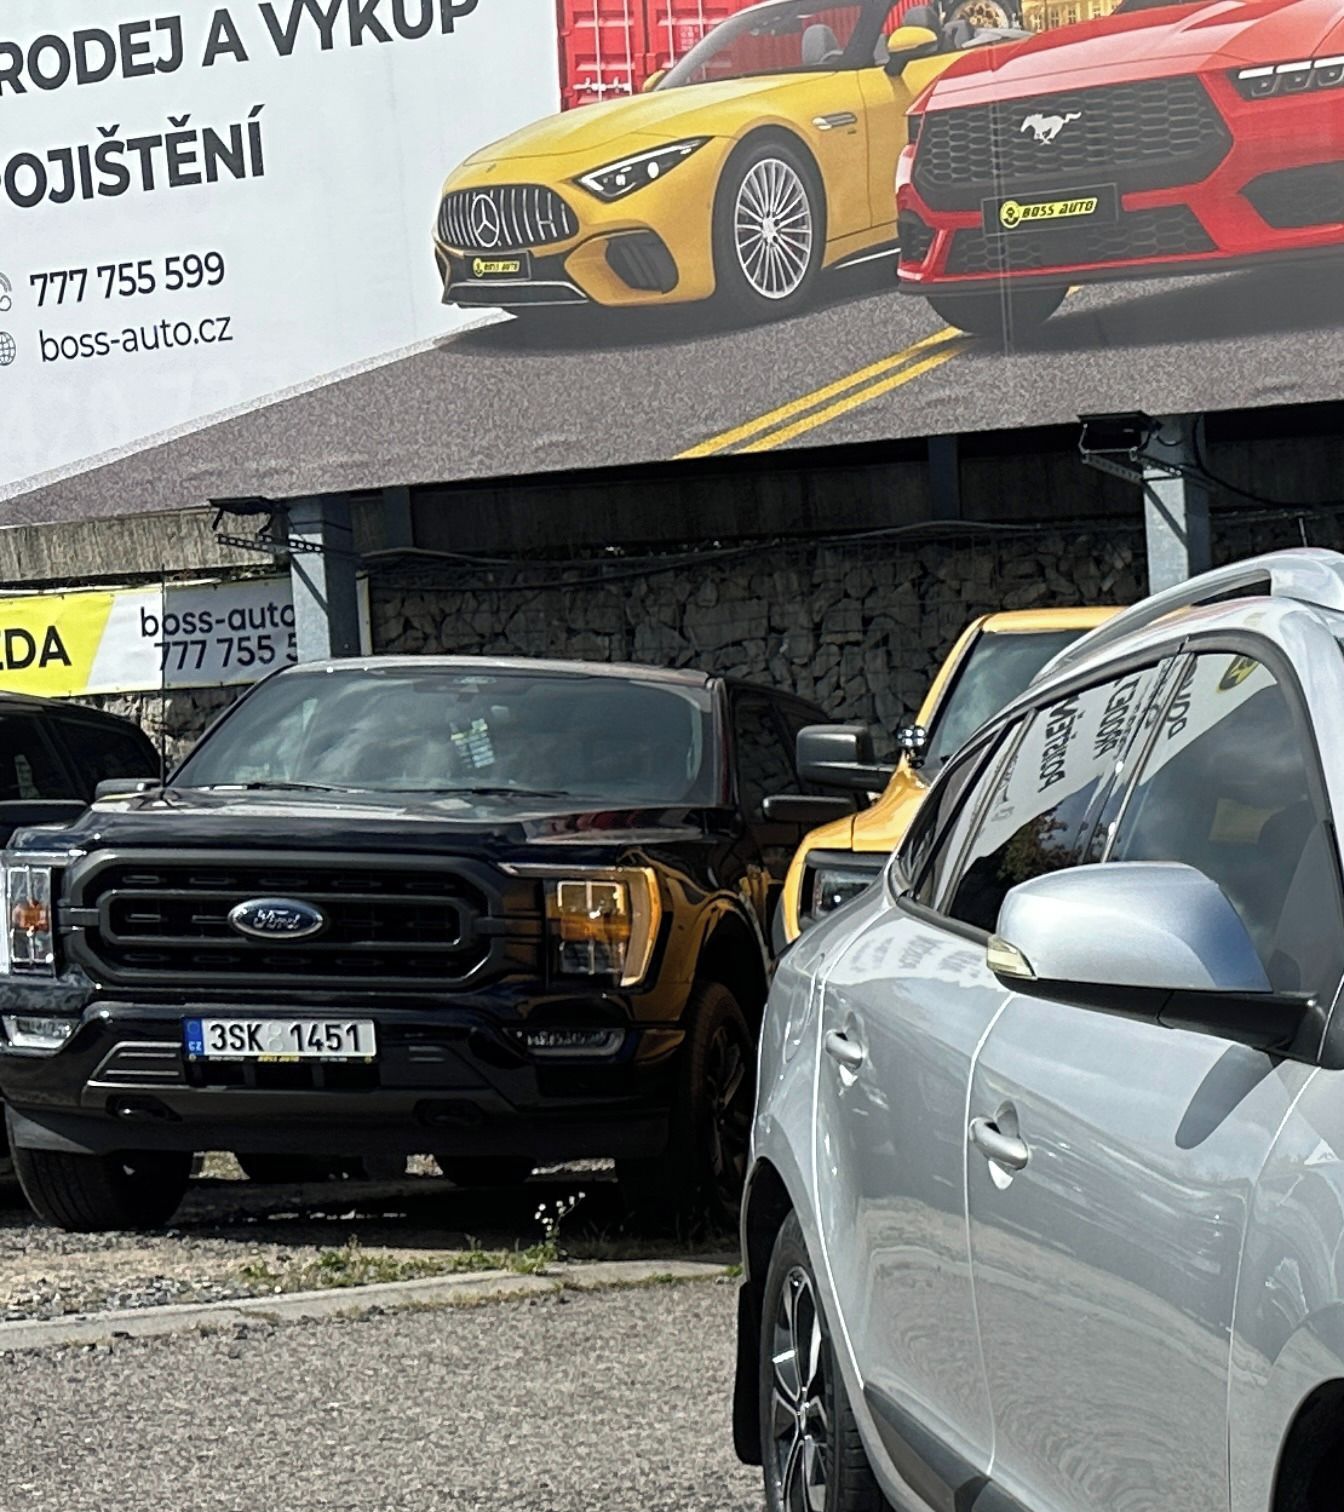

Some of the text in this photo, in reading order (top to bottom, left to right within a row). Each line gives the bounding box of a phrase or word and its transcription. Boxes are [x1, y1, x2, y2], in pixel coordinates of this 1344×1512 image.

[202, 8, 249, 67] A
[0, 104, 266, 208] OJIŠTĚNÍ
[1021, 201, 1094, 218] BOSS AUTO
[29, 251, 225, 307] 777 755 599
[39, 316, 234, 362] boss-auto.cz
[0, 625, 73, 670] DA
[154, 640, 207, 671] 777
[217, 634, 276, 668] 755
[253, 909, 301, 929] Ford
[210, 1023, 361, 1053] 3SK 1451
